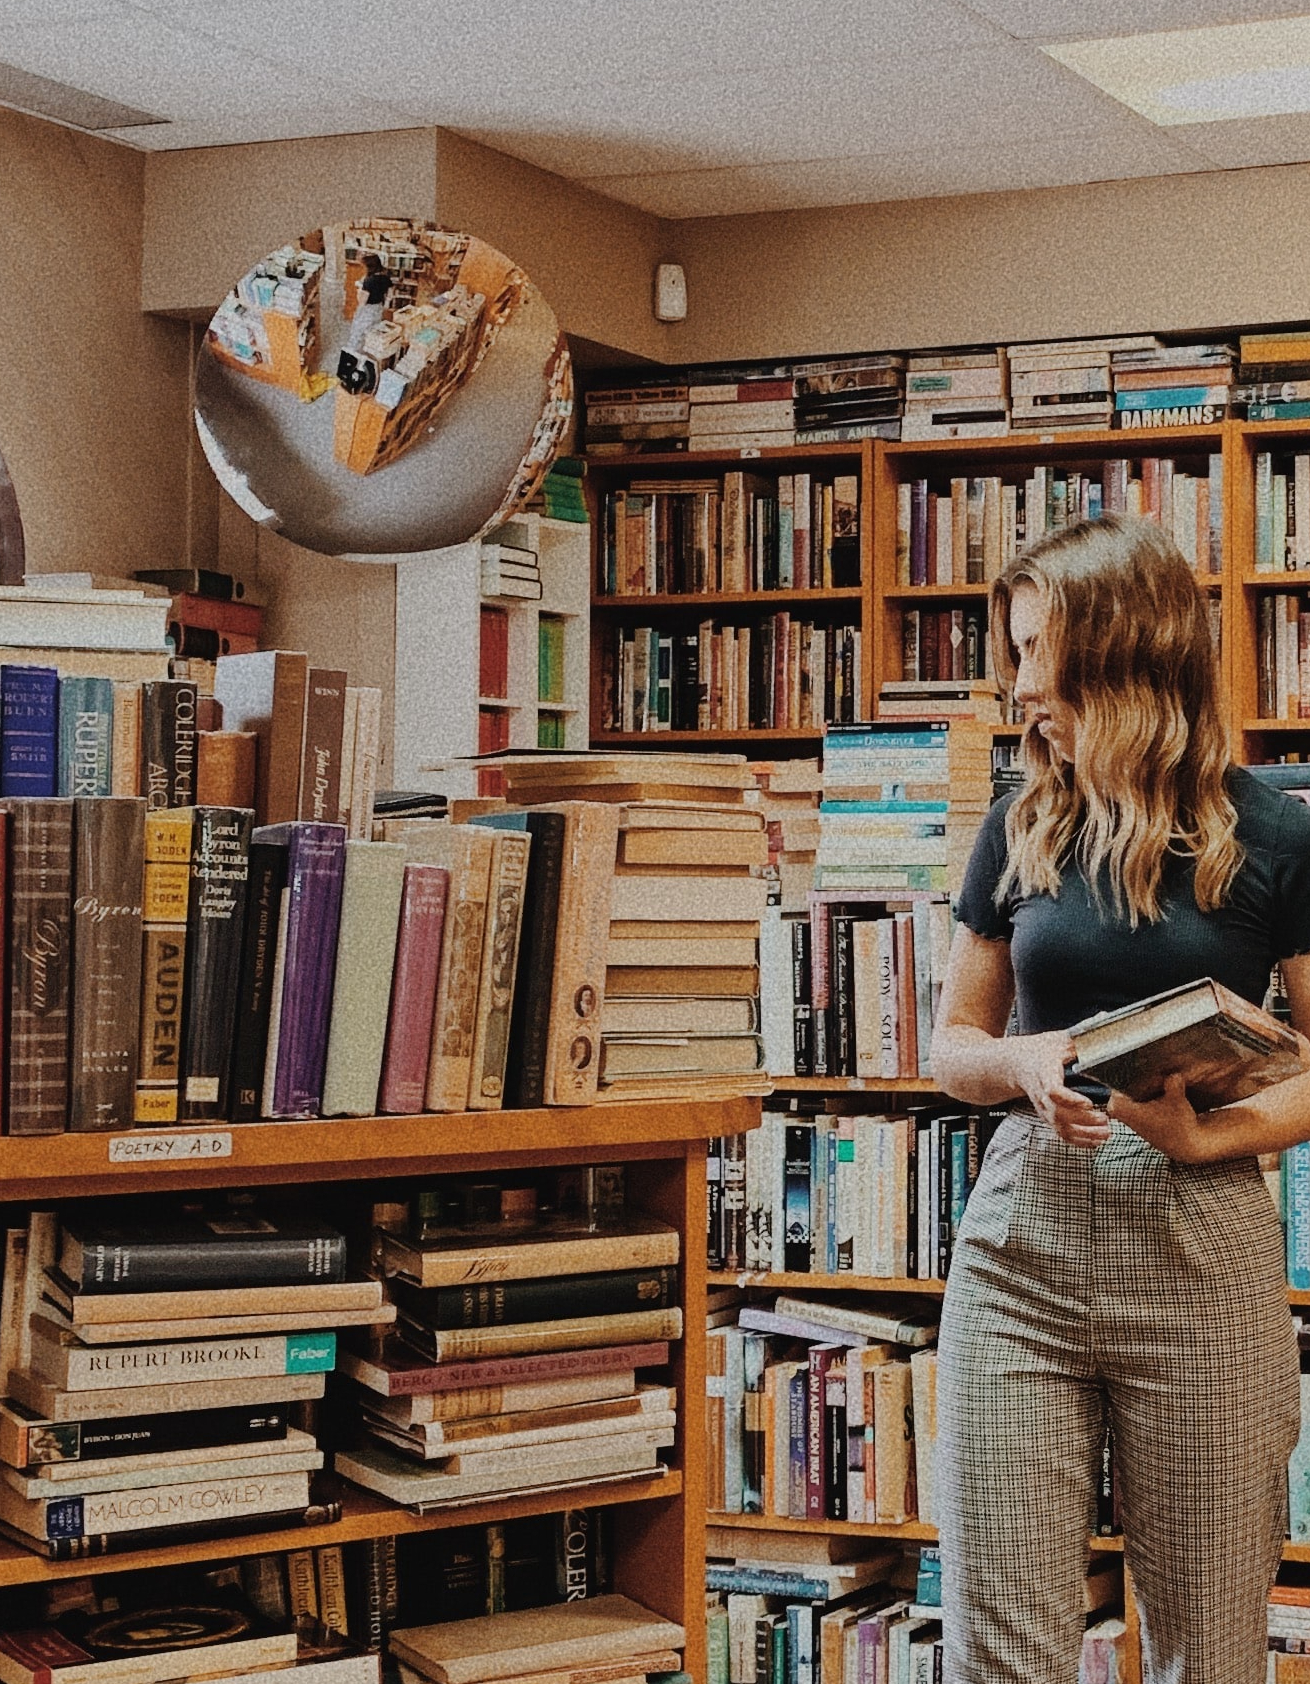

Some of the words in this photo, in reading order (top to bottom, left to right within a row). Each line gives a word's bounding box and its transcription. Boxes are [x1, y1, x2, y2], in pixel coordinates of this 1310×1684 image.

[1120, 405, 1214, 429] DARKMANS
[173, 687, 196, 805] COLERIDGE
[206, 821, 239, 837] Lord
[192, 849, 249, 866] Accounts
[191, 865, 249, 882] Rendered
[72, 896, 143, 923] Byron
[22, 917, 62, 1009] Byron
[152, 939, 180, 1068] AUDEN
[142, 1098, 171, 1110] Faber
[113, 1140, 175, 1156] POETRY
[189, 1138, 223, 1154] A-D
[89, 1350, 173, 1372] RUPERT
[289, 1346, 331, 1363] Faber
[391, 1374, 433, 1389] BERG
[449, 1368, 481, 1382] NEW
[500, 1356, 576, 1376] SELECTED
[809, 1393, 819, 1455] AMERICAN
[86, 1494, 185, 1523] MALCOLM
[188, 1483, 267, 1511] COWLEY
